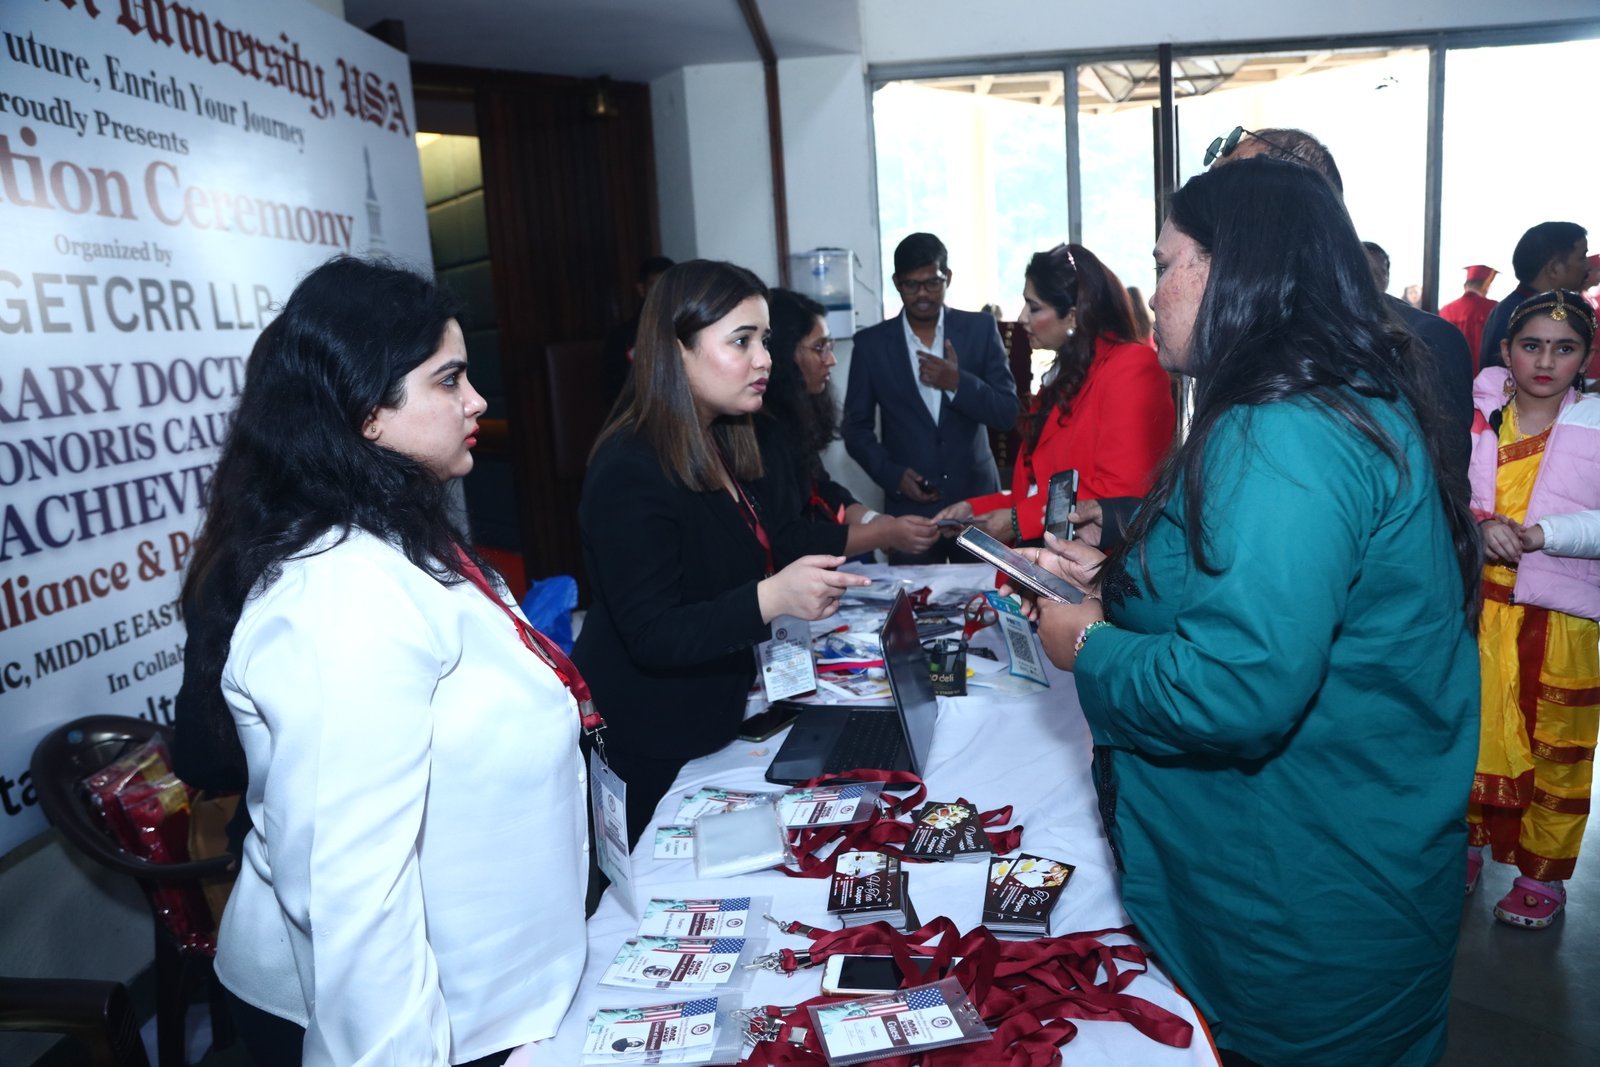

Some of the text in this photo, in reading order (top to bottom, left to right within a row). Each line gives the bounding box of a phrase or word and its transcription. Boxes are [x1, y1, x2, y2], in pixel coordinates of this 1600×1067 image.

[104, 54, 188, 112] Enrich
[190, 83, 238, 127] Your
[241, 100, 305, 153] Journey
[336, 57, 411, 137] USA
[93, 109, 191, 156] Presents
[0, 125, 355, 259] tion Ceremony
[54, 233, 174, 267] Organized by
[0, 269, 274, 335] GETCRR LLP
[0, 421, 156, 487] ONORIS
[137, 540, 166, 582] &
[34, 619, 131, 679] MIDDLE
[107, 673, 131, 694] In
[939, 673, 955, 683] deli
[926, 836, 940, 853] Coupon
[935, 828, 957, 855] Dinner
[854, 885, 864, 905] Coupon
[1013, 893, 1030, 912] Coupon
[1028, 889, 1050, 907] Tea
[886, 1020, 902, 1041] Guest
